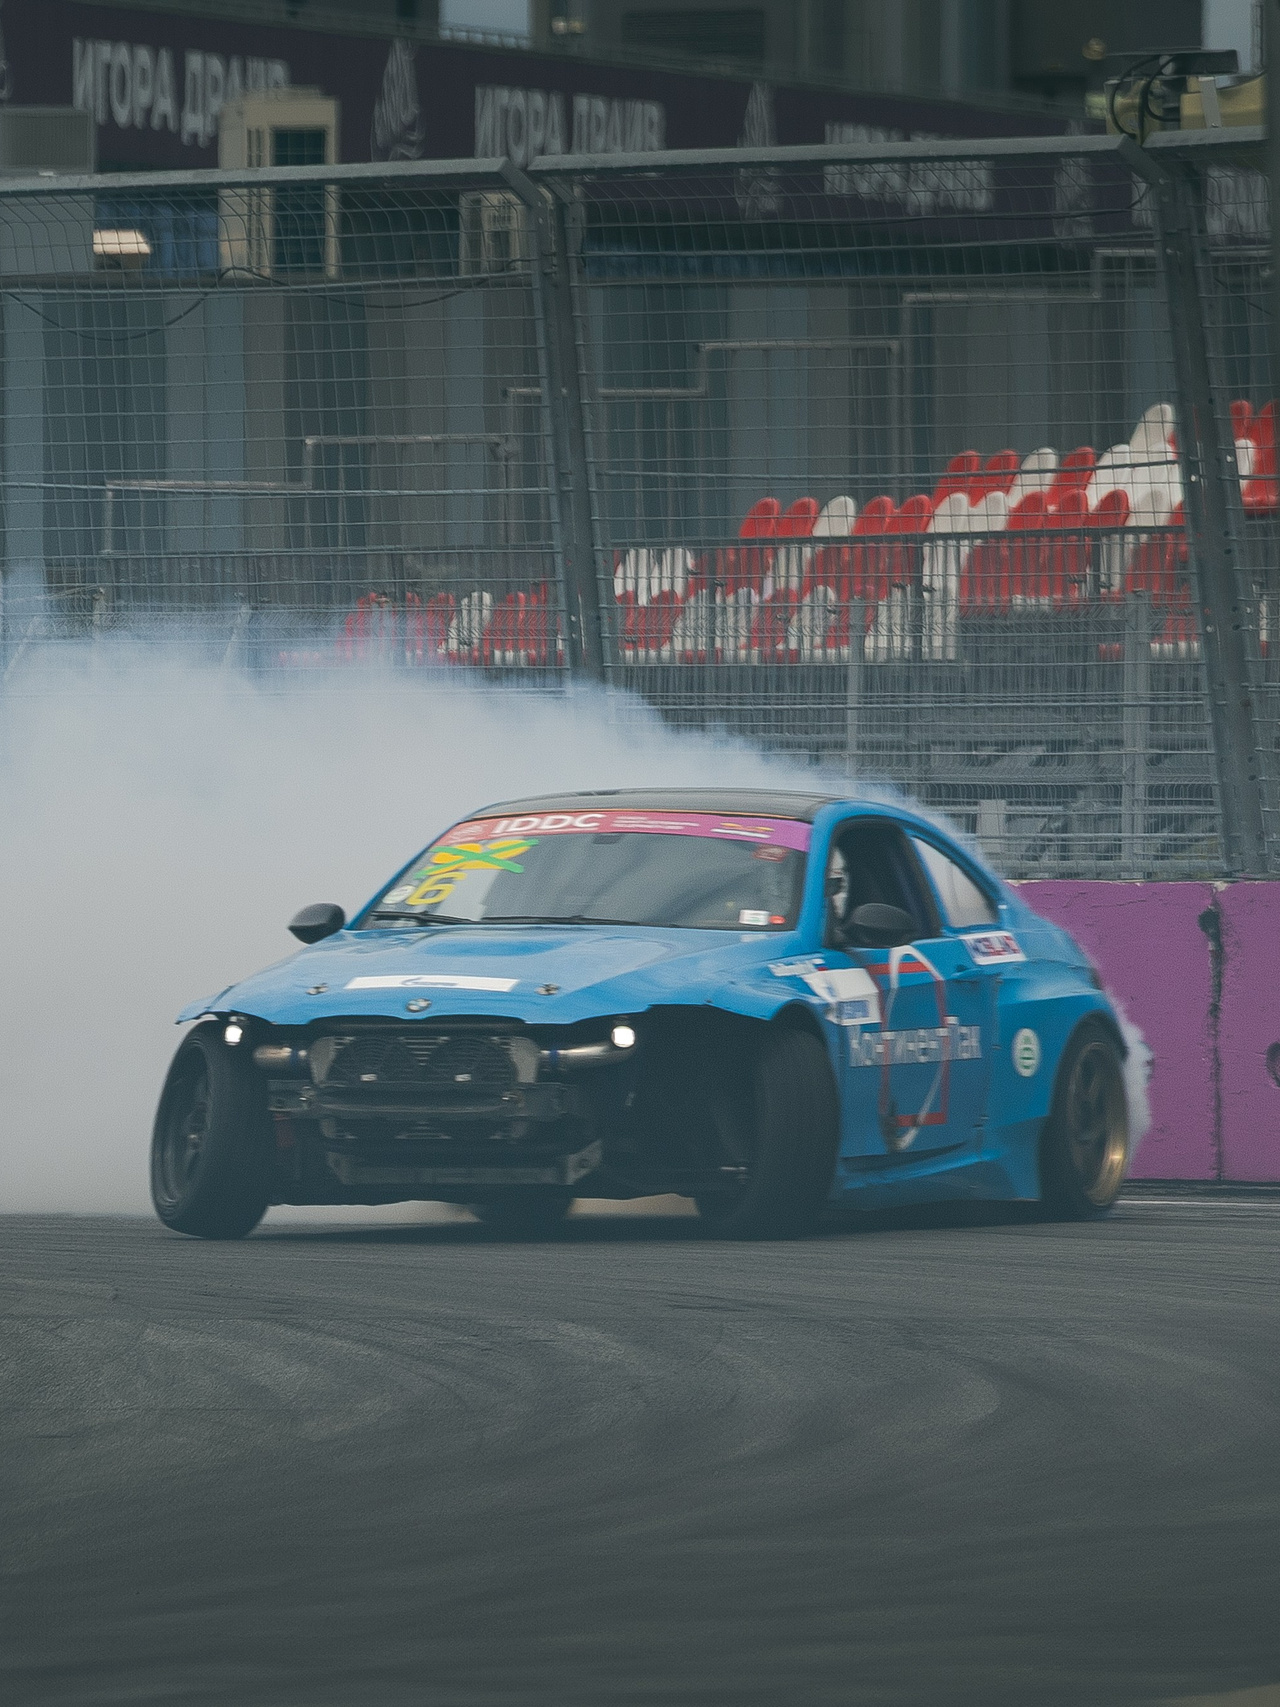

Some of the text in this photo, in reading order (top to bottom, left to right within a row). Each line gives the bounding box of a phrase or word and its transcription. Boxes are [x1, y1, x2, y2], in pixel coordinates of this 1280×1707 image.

[72, 37, 180, 133] ИГОРА
[493, 814, 604, 833] IDDC
[405, 871, 467, 906] 6
